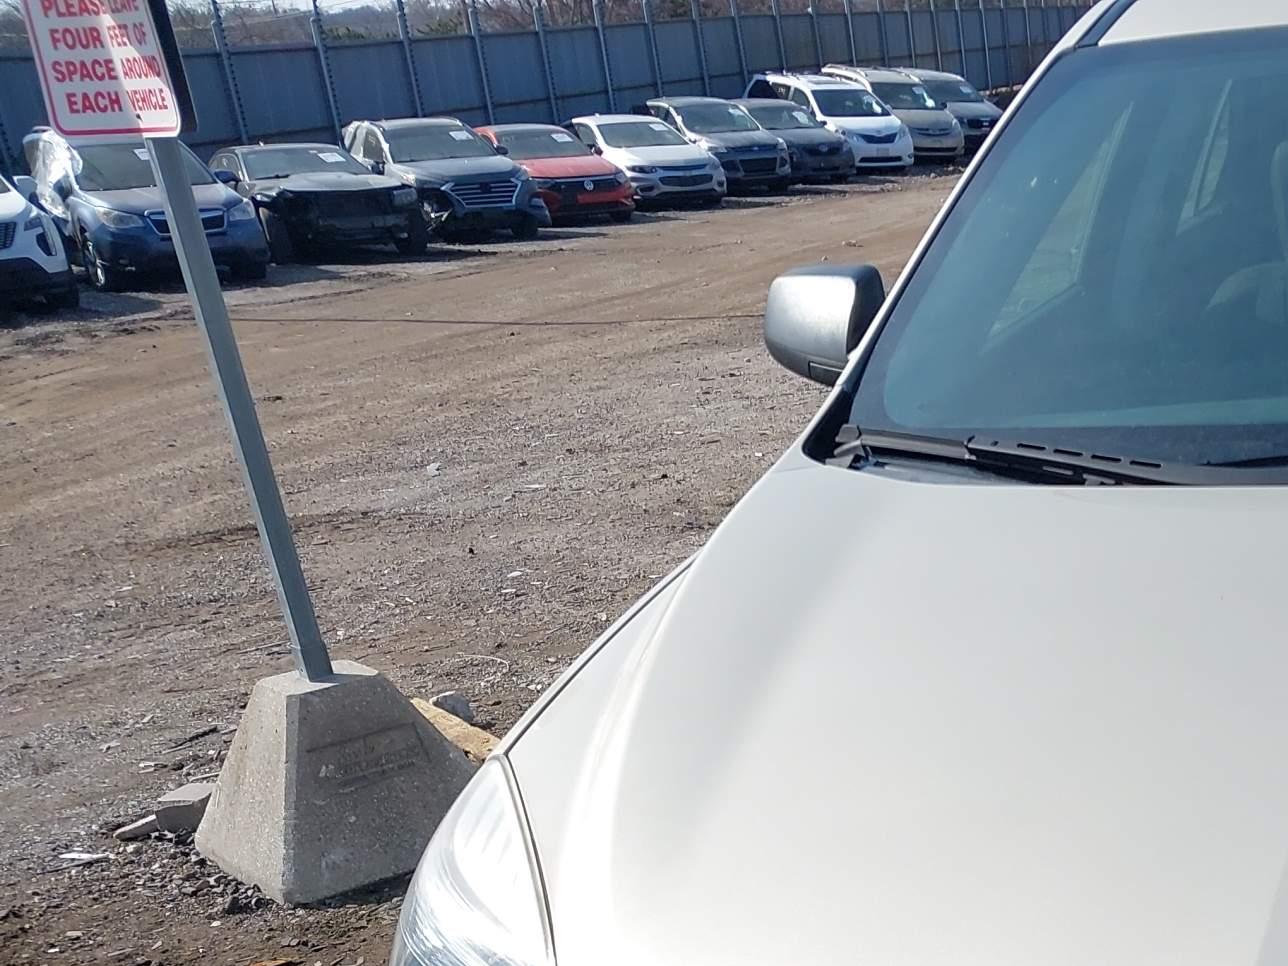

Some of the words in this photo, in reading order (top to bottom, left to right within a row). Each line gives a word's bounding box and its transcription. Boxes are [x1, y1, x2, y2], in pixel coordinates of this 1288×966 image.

[49, 27, 104, 50] FOUR
[106, 24, 132, 48] FEET
[133, 22, 147, 46] OF
[51, 58, 118, 82] SPACE
[120, 55, 162, 80] AROUND
[65, 91, 123, 114] EACH
[126, 88, 169, 112] VEHICLE
